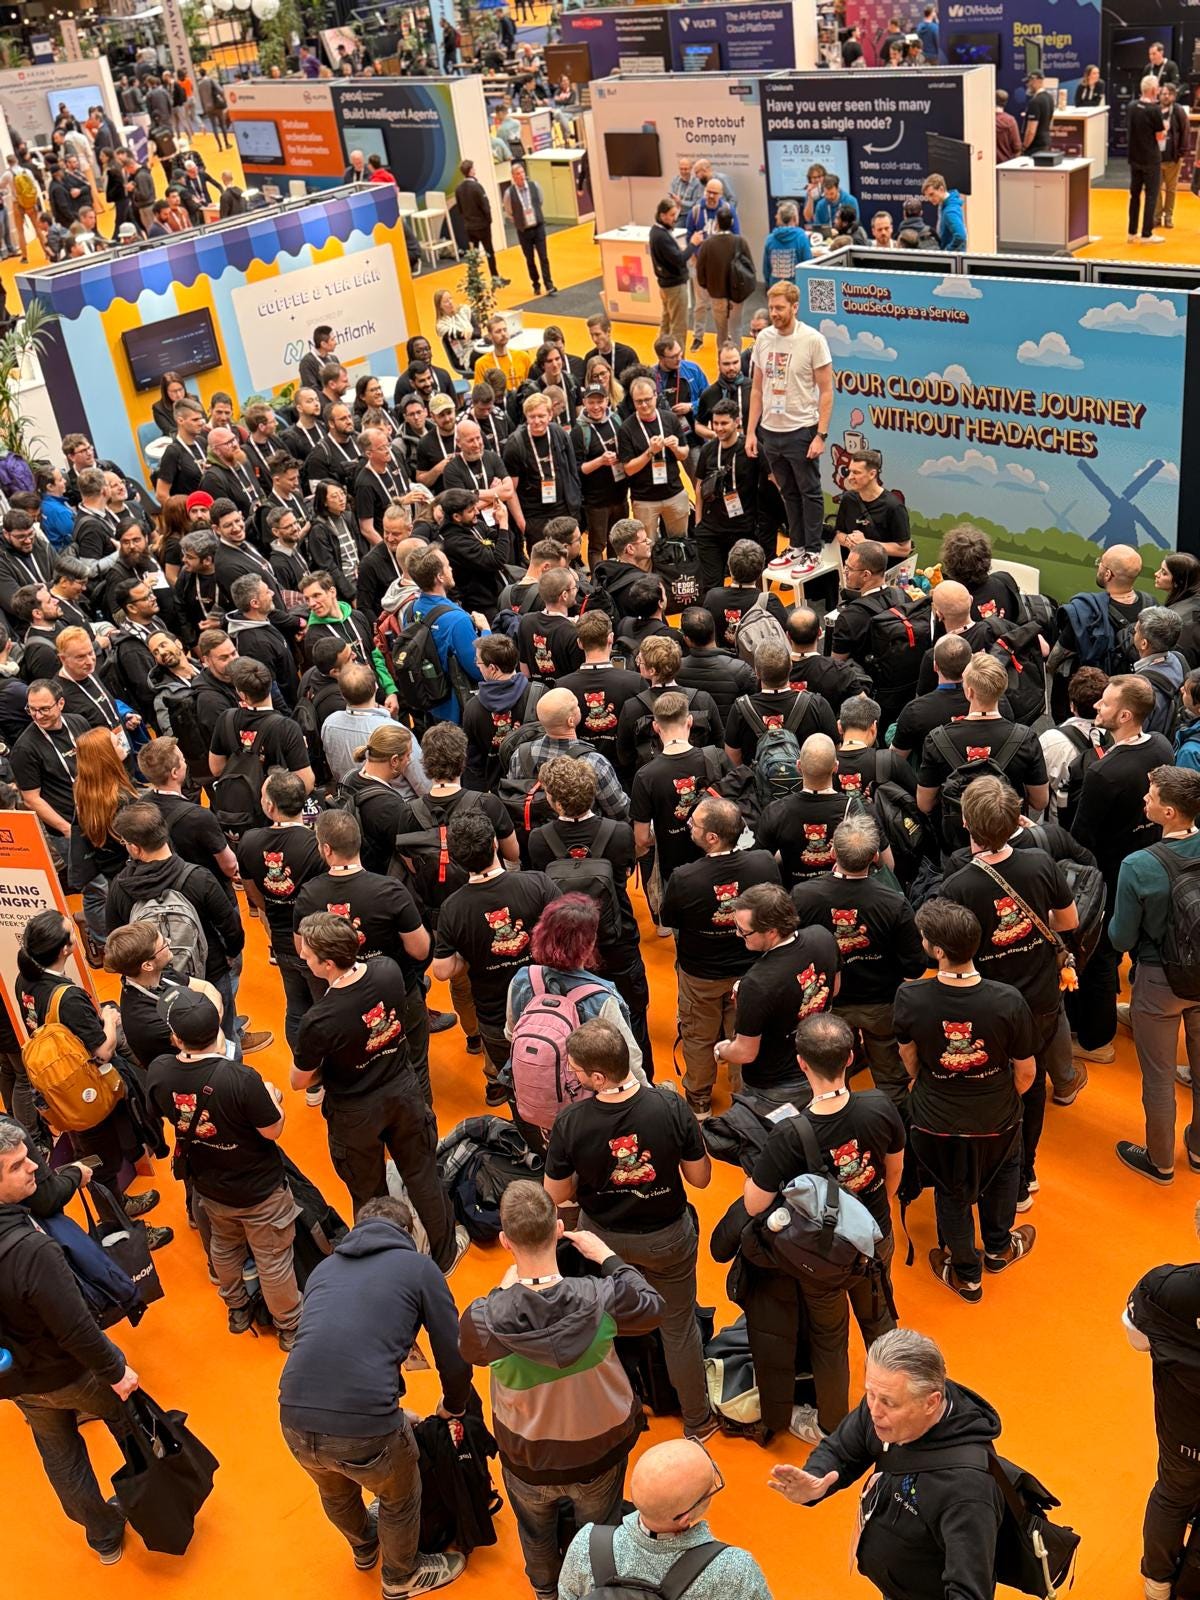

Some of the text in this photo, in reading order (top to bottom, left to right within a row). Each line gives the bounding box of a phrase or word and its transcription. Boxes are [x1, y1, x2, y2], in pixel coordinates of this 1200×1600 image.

[761, 9, 783, 19] Global
[964, 4, 1004, 16] OVHcloud
[692, 18, 717, 29] VULTR
[726, 22, 775, 33] Cloud Platform
[1013, 22, 1042, 36] Born
[766, 98, 931, 114] Have you ever seen this many
[342, 107, 438, 122] Build Intelligent Agents
[674, 116, 746, 128] The Protobuf
[768, 116, 892, 132] pods on a single node?
[685, 131, 736, 145] Company
[782, 144, 831, 155] 1,018,419
[860, 160, 923, 170] 10ms cold-starts.
[860, 176, 879, 185] 100x
[880, 177, 902, 185] server
[861, 192, 872, 200] No
[872, 193, 892, 201] more
[257, 291, 310, 317] COFFEE
[325, 279, 351, 296] TEA
[354, 270, 381, 287] BAR
[841, 282, 890, 301] KumoOps
[842, 300, 906, 320] CloudSecOps
[907, 308, 920, 319] as
[929, 306, 968, 324] Service
[832, 368, 1146, 428] YOUR CLOUD NATIVE JOURNEY
[868, 404, 1098, 457] WITHOUT HEADACHES
[0, 897, 47, 909] NGRY?
